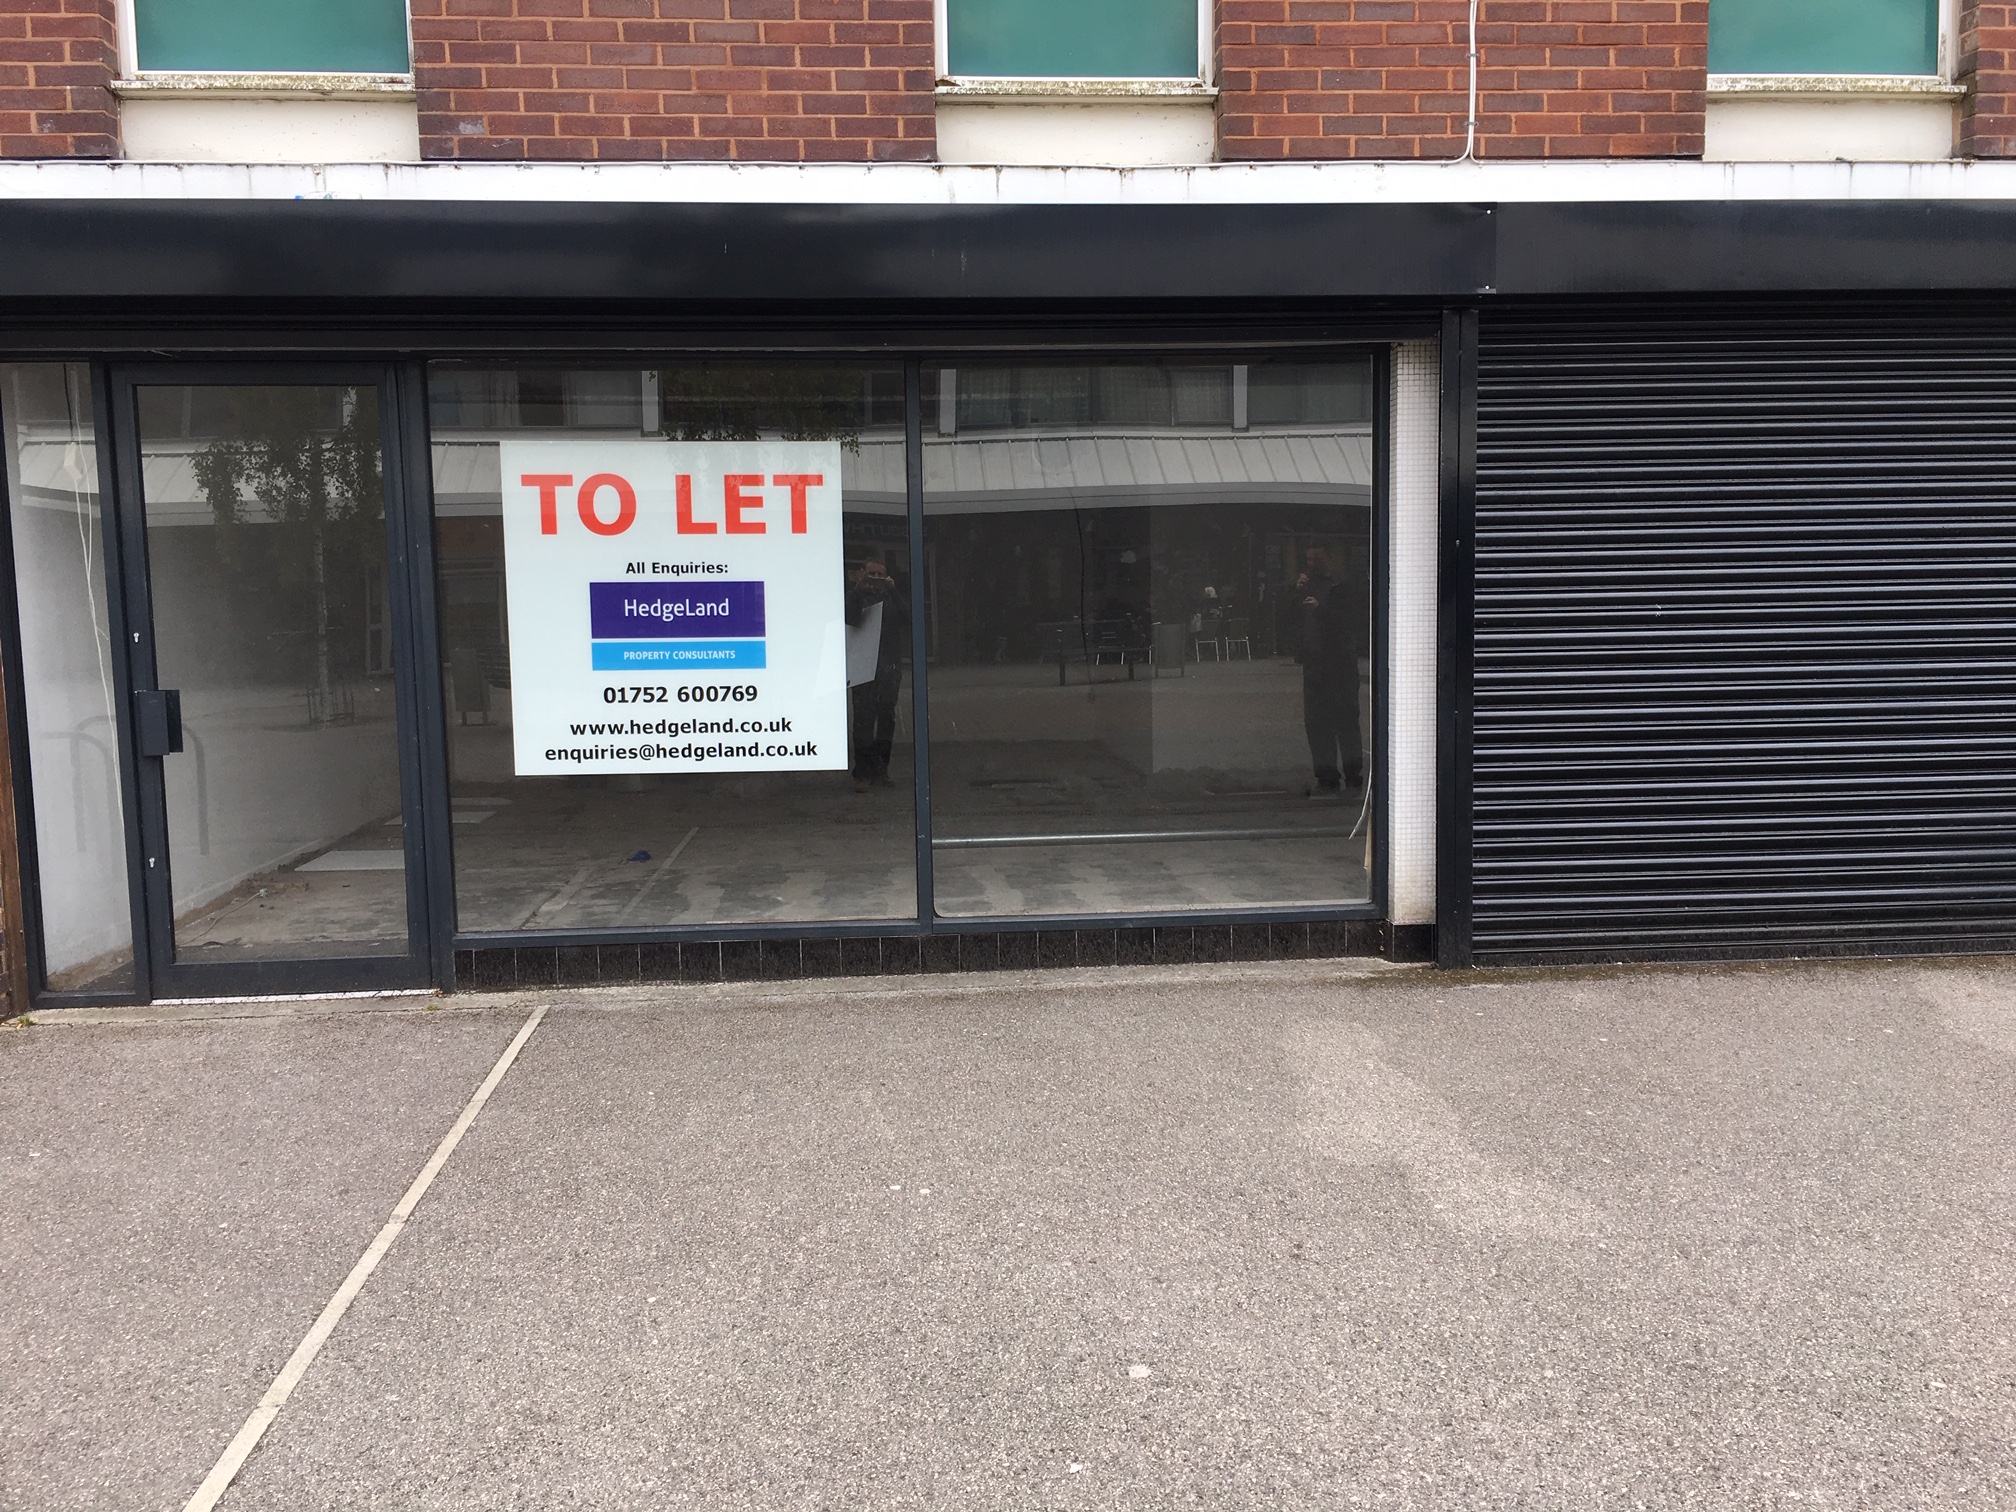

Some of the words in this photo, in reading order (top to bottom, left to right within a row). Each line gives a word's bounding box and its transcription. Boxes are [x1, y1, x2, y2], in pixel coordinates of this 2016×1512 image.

[521, 473, 637, 536] TO
[676, 474, 823, 534] LET
[625, 561, 646, 574] All
[652, 562, 728, 576] Enquiries:
[625, 598, 729, 621] HedgeLand
[623, 651, 671, 660] PROPERTY
[672, 650, 736, 660] CONSULTANTS
[604, 687, 668, 703] 01752
[678, 686, 757, 702] 600769
[570, 718, 792, 737] www.hedgeland.co.uk
[545, 741, 817, 763] enquiries@hedgeland.co.uk
